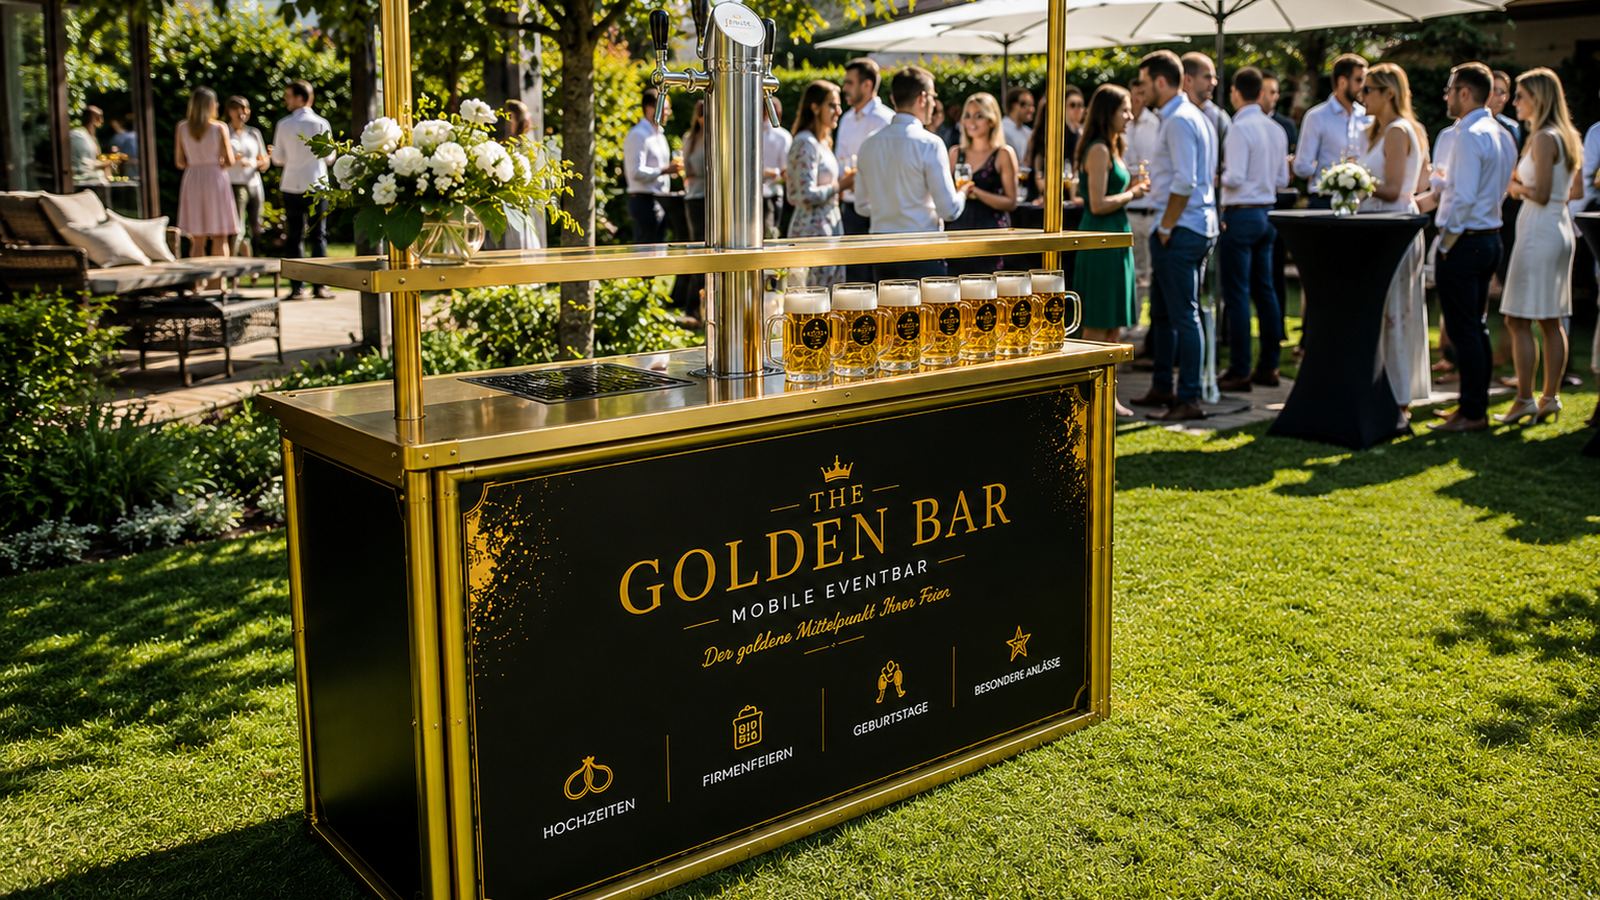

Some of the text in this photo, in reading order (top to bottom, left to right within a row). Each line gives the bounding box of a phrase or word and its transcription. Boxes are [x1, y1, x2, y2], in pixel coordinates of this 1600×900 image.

[810, 483, 864, 513] THE
[620, 483, 1011, 615] GOLDEN BAR
[732, 559, 927, 624] MOBILE EVENTBAR
[702, 646, 734, 668] Der
[736, 631, 793, 665] goldene
[796, 605, 876, 641] Mittelpunkt
[974, 669, 1025, 696] BESONDERE
[853, 701, 929, 738] GEBURTSTAGE
[702, 746, 793, 788] FIRMENFEIERN
[543, 798, 636, 840] HOCHZEITEN
